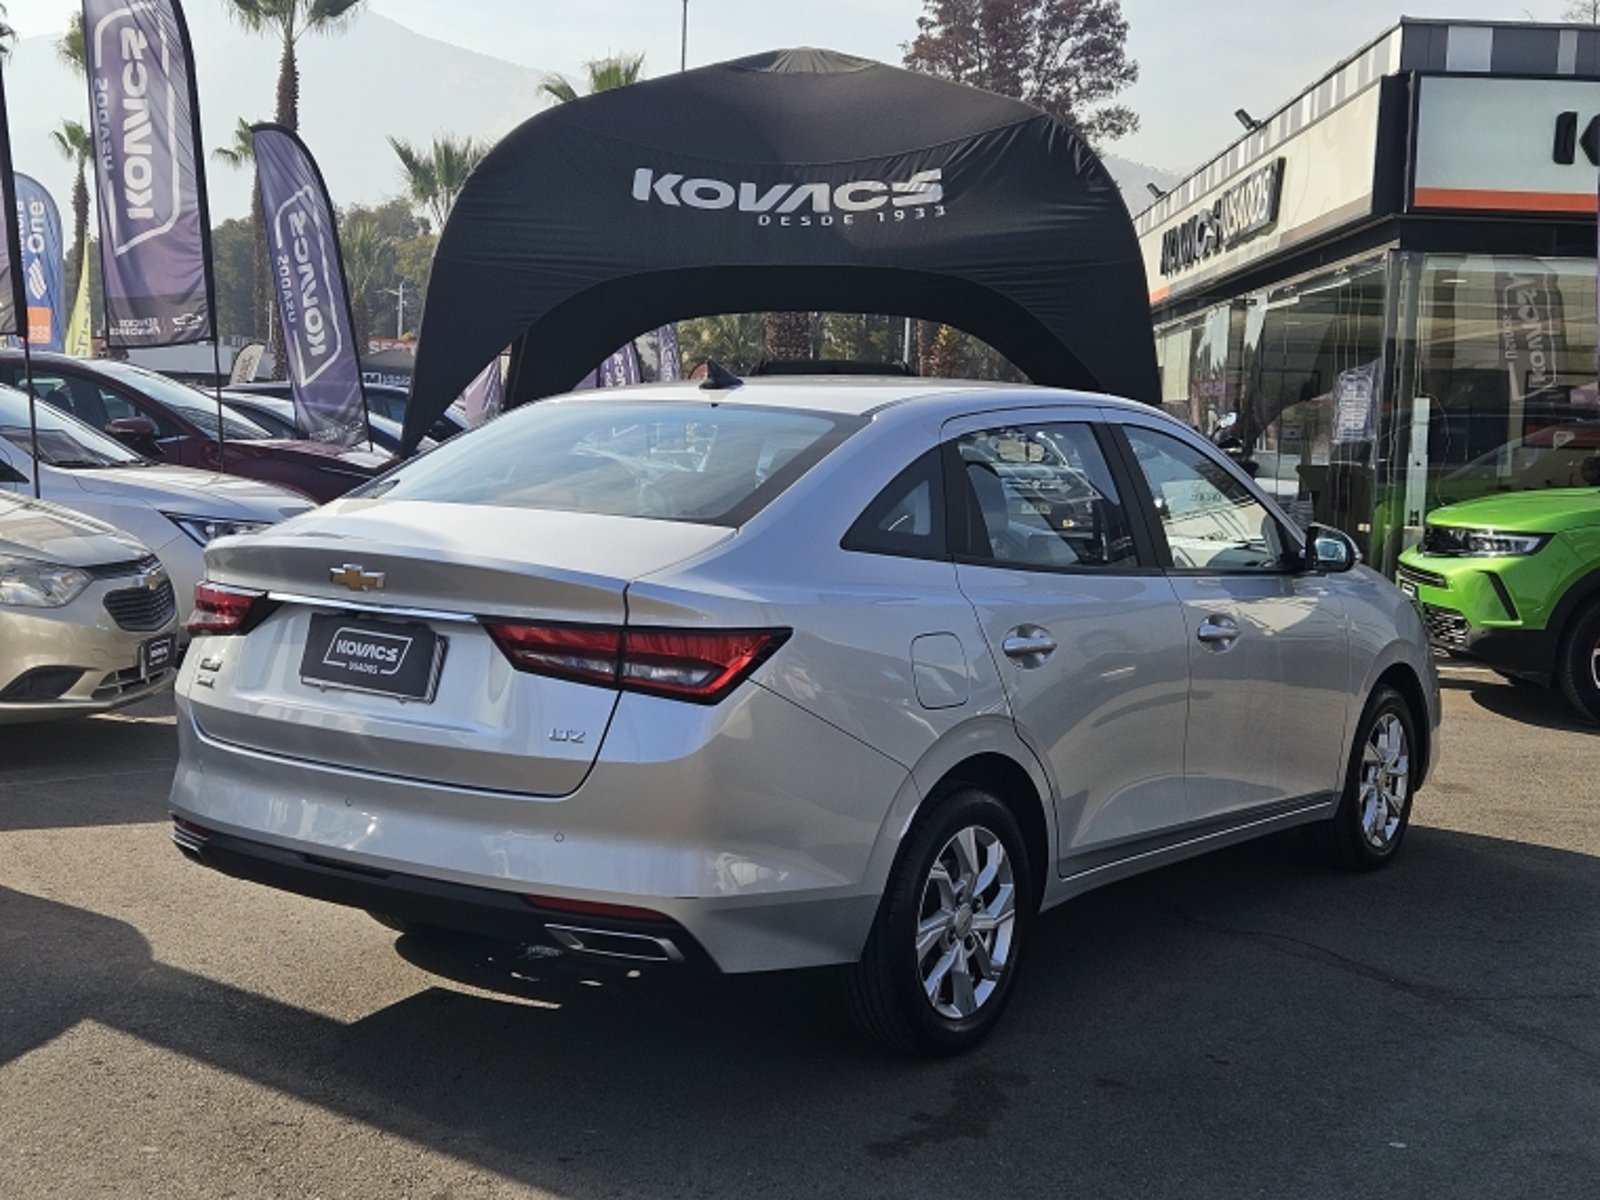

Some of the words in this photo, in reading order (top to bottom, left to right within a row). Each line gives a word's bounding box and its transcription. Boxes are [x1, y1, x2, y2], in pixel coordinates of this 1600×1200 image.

[632, 167, 944, 213] KOVACS
[757, 213, 854, 226] DESDE
[876, 205, 946, 222] 1933
[335, 640, 399, 662] KOVACS
